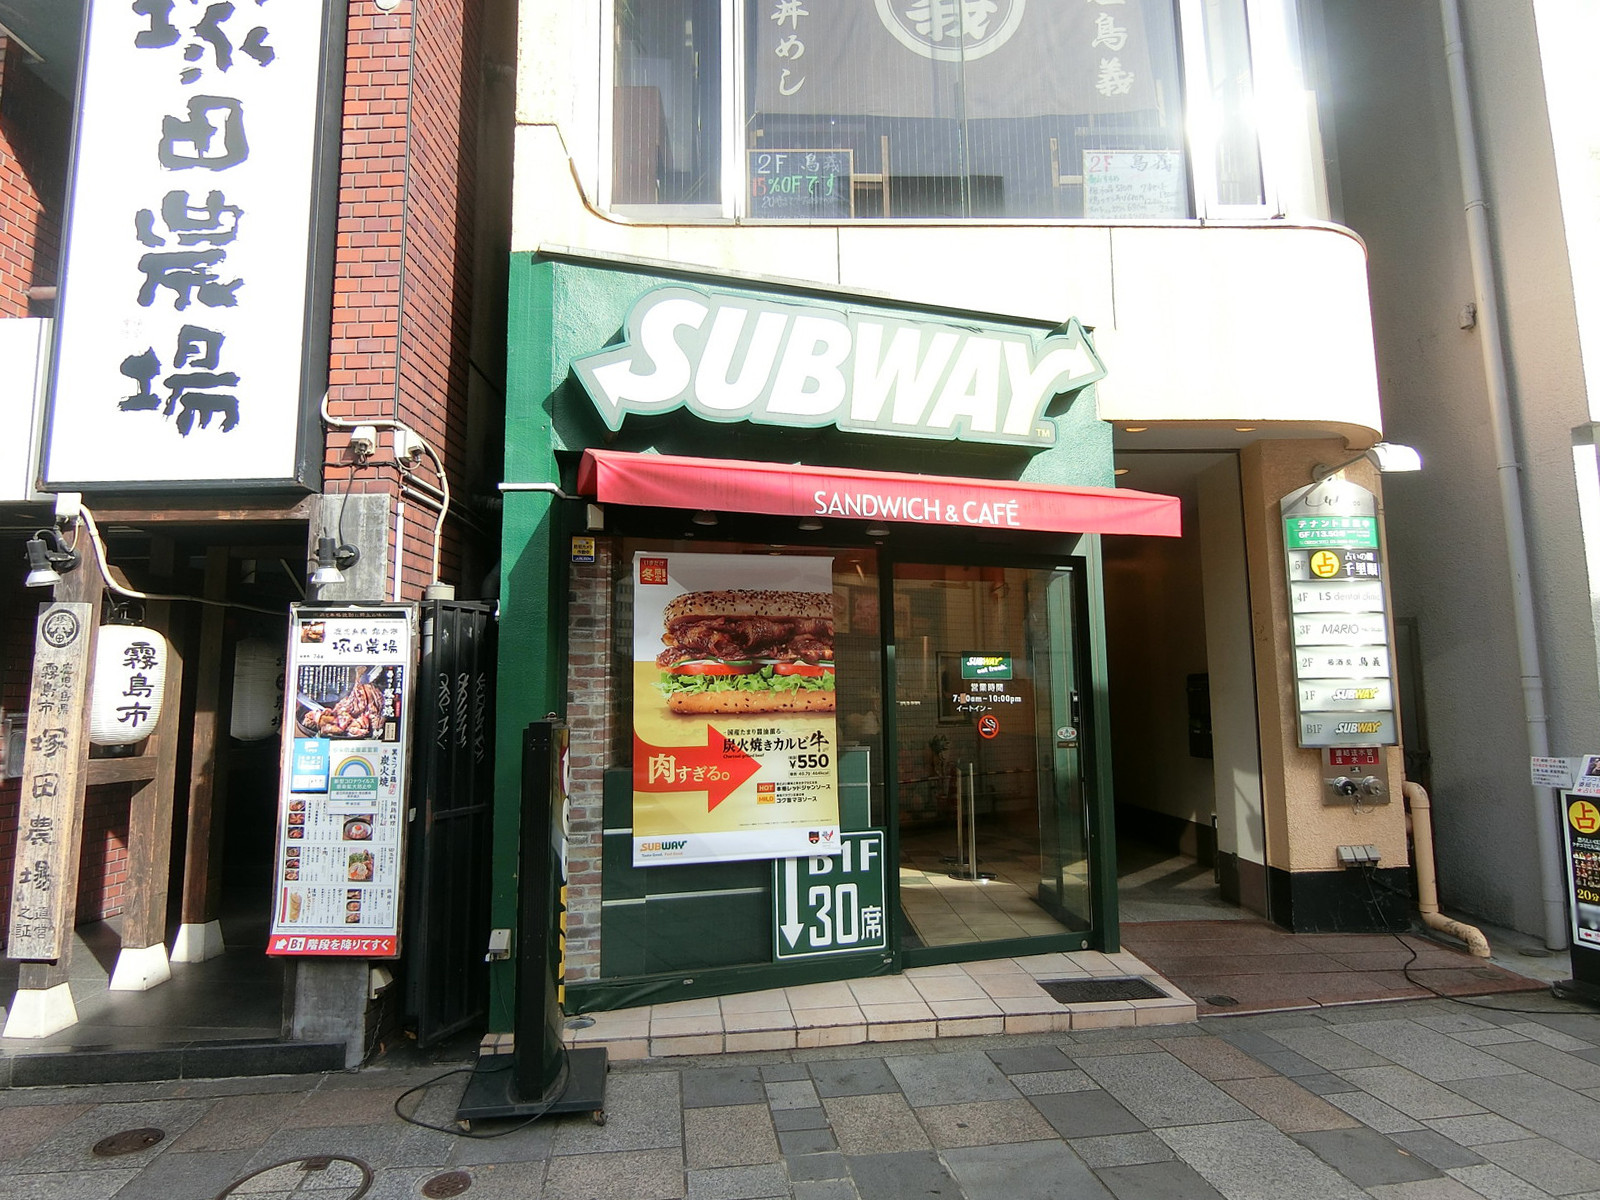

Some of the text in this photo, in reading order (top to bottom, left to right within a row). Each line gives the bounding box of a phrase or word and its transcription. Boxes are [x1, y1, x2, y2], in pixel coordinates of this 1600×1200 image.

[758, 153, 788, 174] 2F
[592, 296, 1096, 435] SUBWAY
[813, 490, 1021, 526] SANDWICH & CAFÉ
[1317, 552, 1335, 575] 占
[1300, 625, 1311, 635] 3F
[1321, 623, 1359, 635] MARIO
[966, 656, 1003, 666] SUBWAY
[116, 641, 159, 728] 霧島市
[1331, 687, 1379, 701] SUBWAY
[1335, 720, 1382, 735] SUBWAY
[723, 730, 830, 753] 炭火焼きカルビ牛
[648, 753, 730, 785] 肉すぎる。
[19, 726, 68, 892] 塚田農場
[1575, 802, 1596, 830] 占
[640, 840, 687, 852] SUBWAY
[808, 883, 882, 947] 30席
[305, 938, 391, 951] 階段を降りてすぐ
